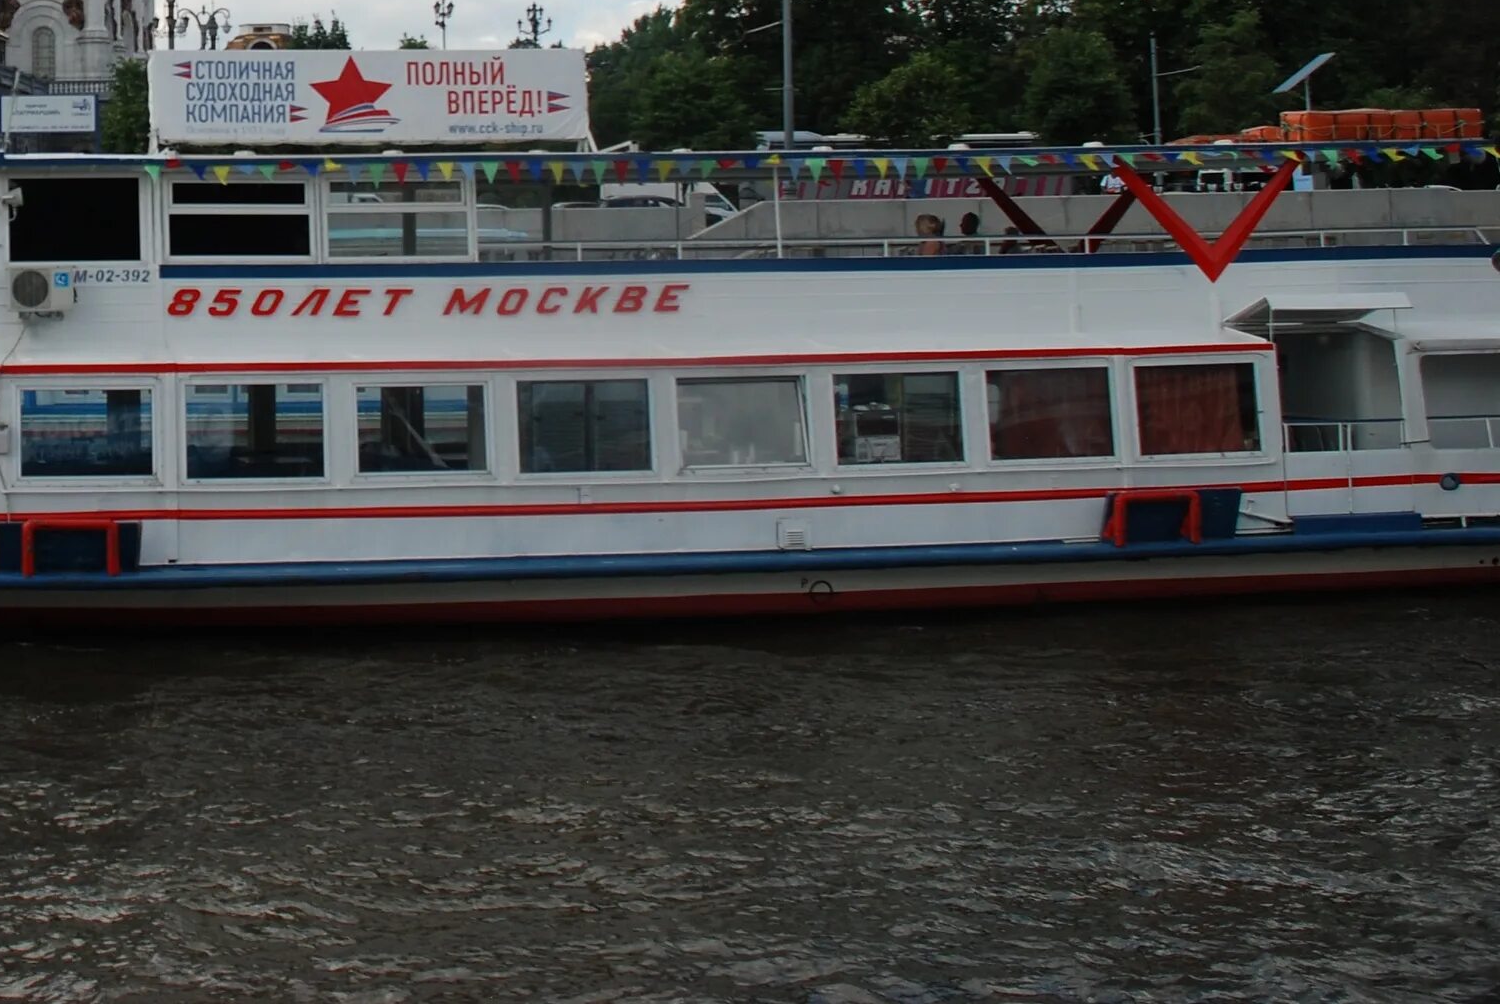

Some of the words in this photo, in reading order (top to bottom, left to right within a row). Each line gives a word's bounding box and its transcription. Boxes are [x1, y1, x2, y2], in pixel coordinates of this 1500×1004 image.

[195, 61, 295, 80] СТОЛИЧНАЯ
[407, 57, 504, 85] ПОЛНЫЙ
[185, 82, 295, 103] СУДОХОДНАЯ
[448, 85, 542, 117] ВПЕРЁД!
[185, 103, 286, 123] КОМПАНИЯ
[74, 269, 150, 284] М-02-392
[442, 284, 690, 316] МОСКВЕ
